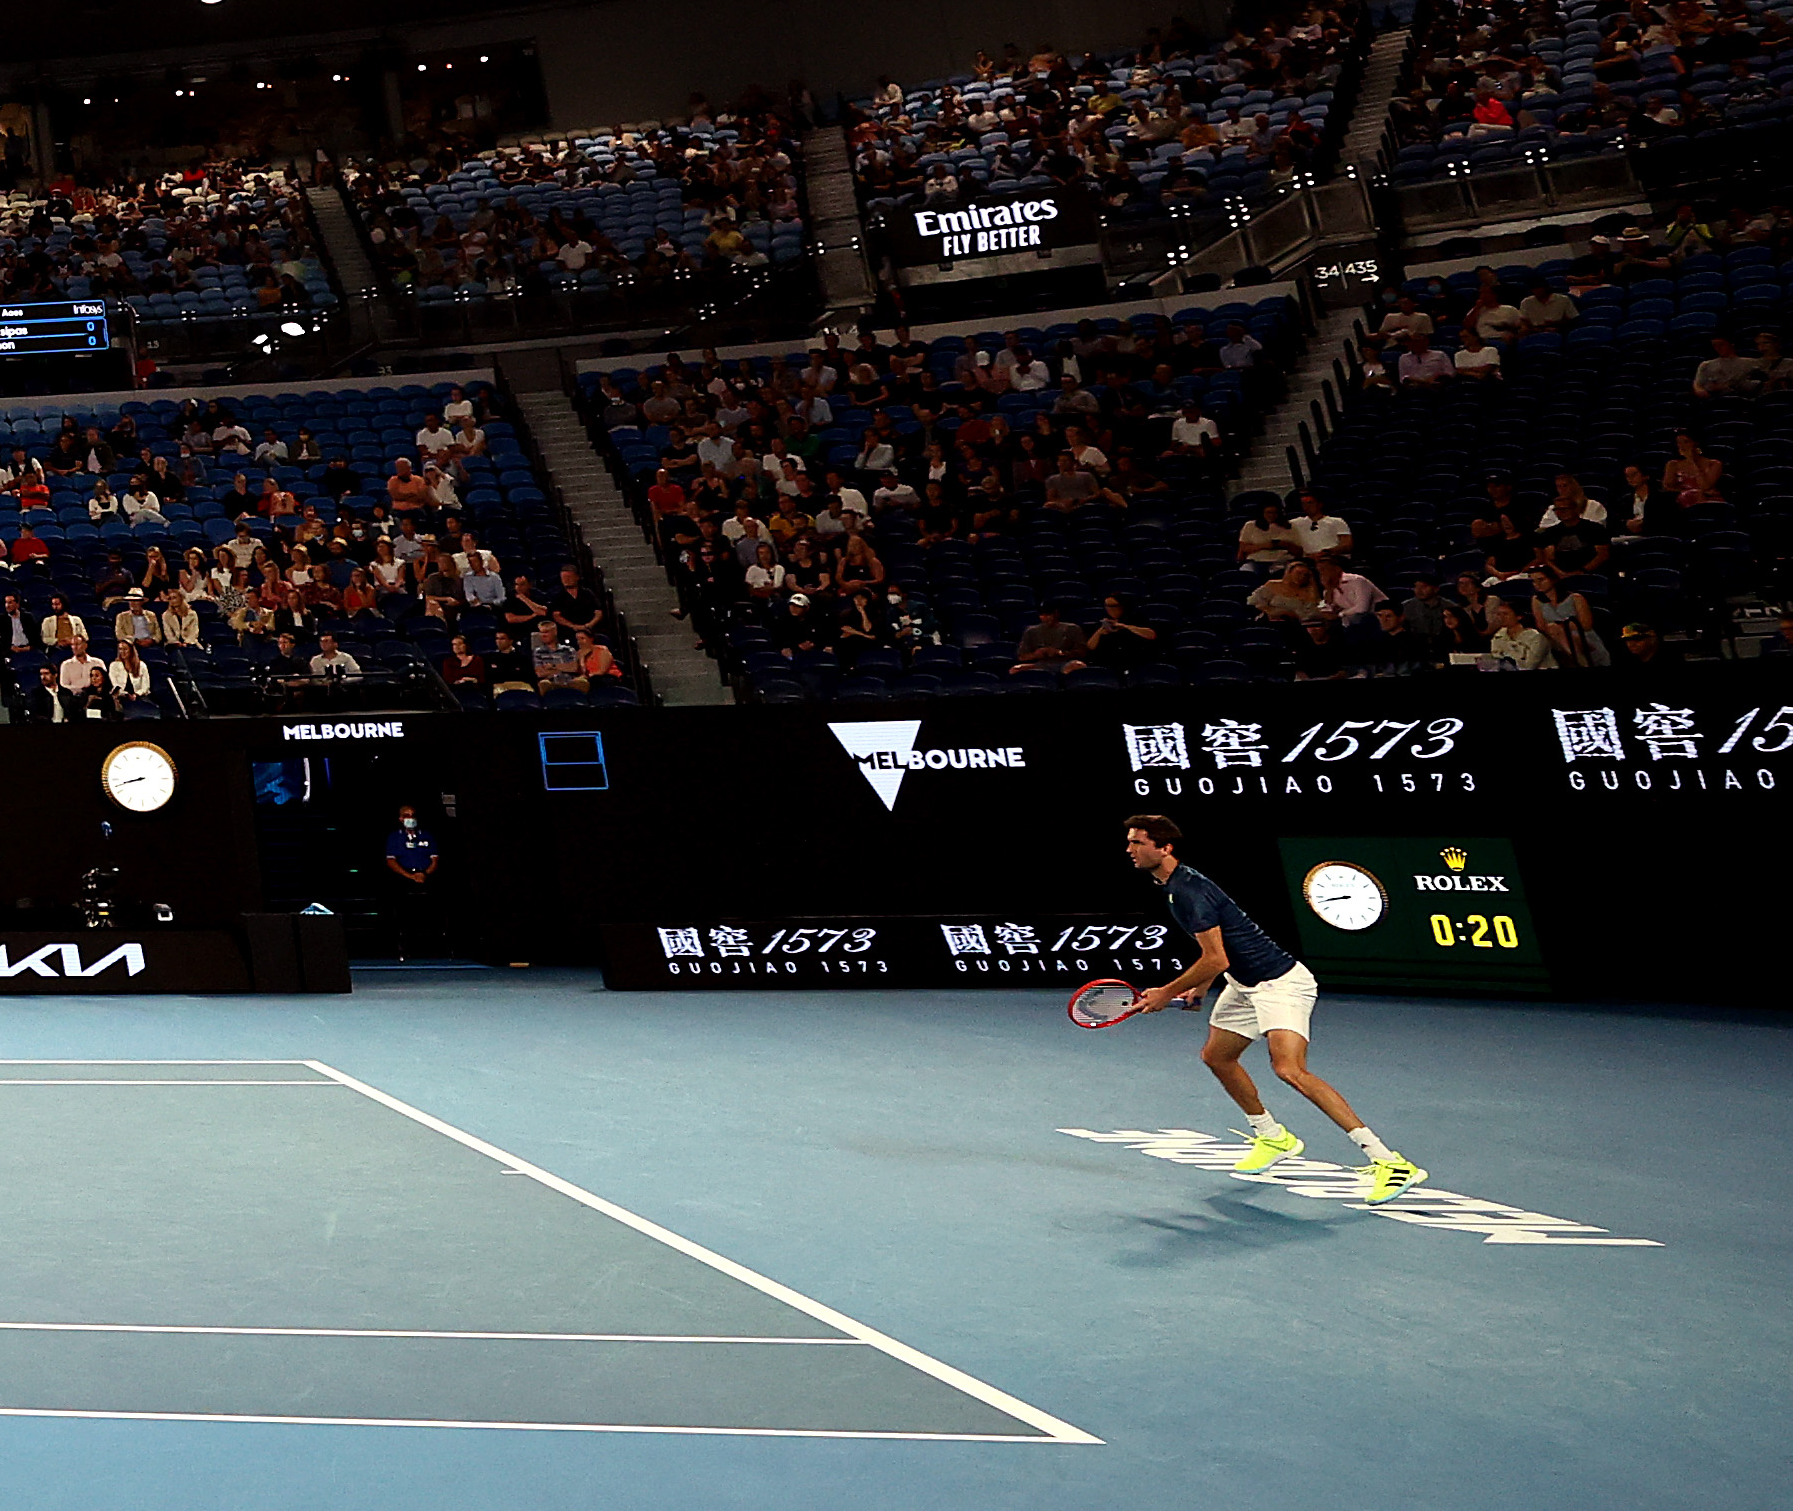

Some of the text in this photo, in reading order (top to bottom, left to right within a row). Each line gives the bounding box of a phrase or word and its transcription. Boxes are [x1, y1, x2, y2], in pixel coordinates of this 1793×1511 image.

[914, 198, 1059, 237] Emirates
[942, 224, 1041, 257] FLY BETTER
[86, 322, 95, 331] 0
[88, 336, 96, 345] 0
[283, 722, 404, 741] MELBOURNE
[1551, 702, 1704, 763] 國窖
[1122, 718, 1464, 771] 國窖 1573
[853, 748, 1026, 771] MELBOURNE
[1134, 773, 1476, 796] GUOJIAO 1573
[1569, 769, 1775, 790] GUOJIAO
[1414, 875, 1509, 892] ROLEX
[657, 925, 878, 959] 國窖 1573
[940, 922, 1168, 956] 國窖 1573
[1430, 914, 1519, 948] 0:20
[669, 960, 889, 975] GUOJIAO 1573
[955, 958, 1183, 972] GUOJIAO 1573
